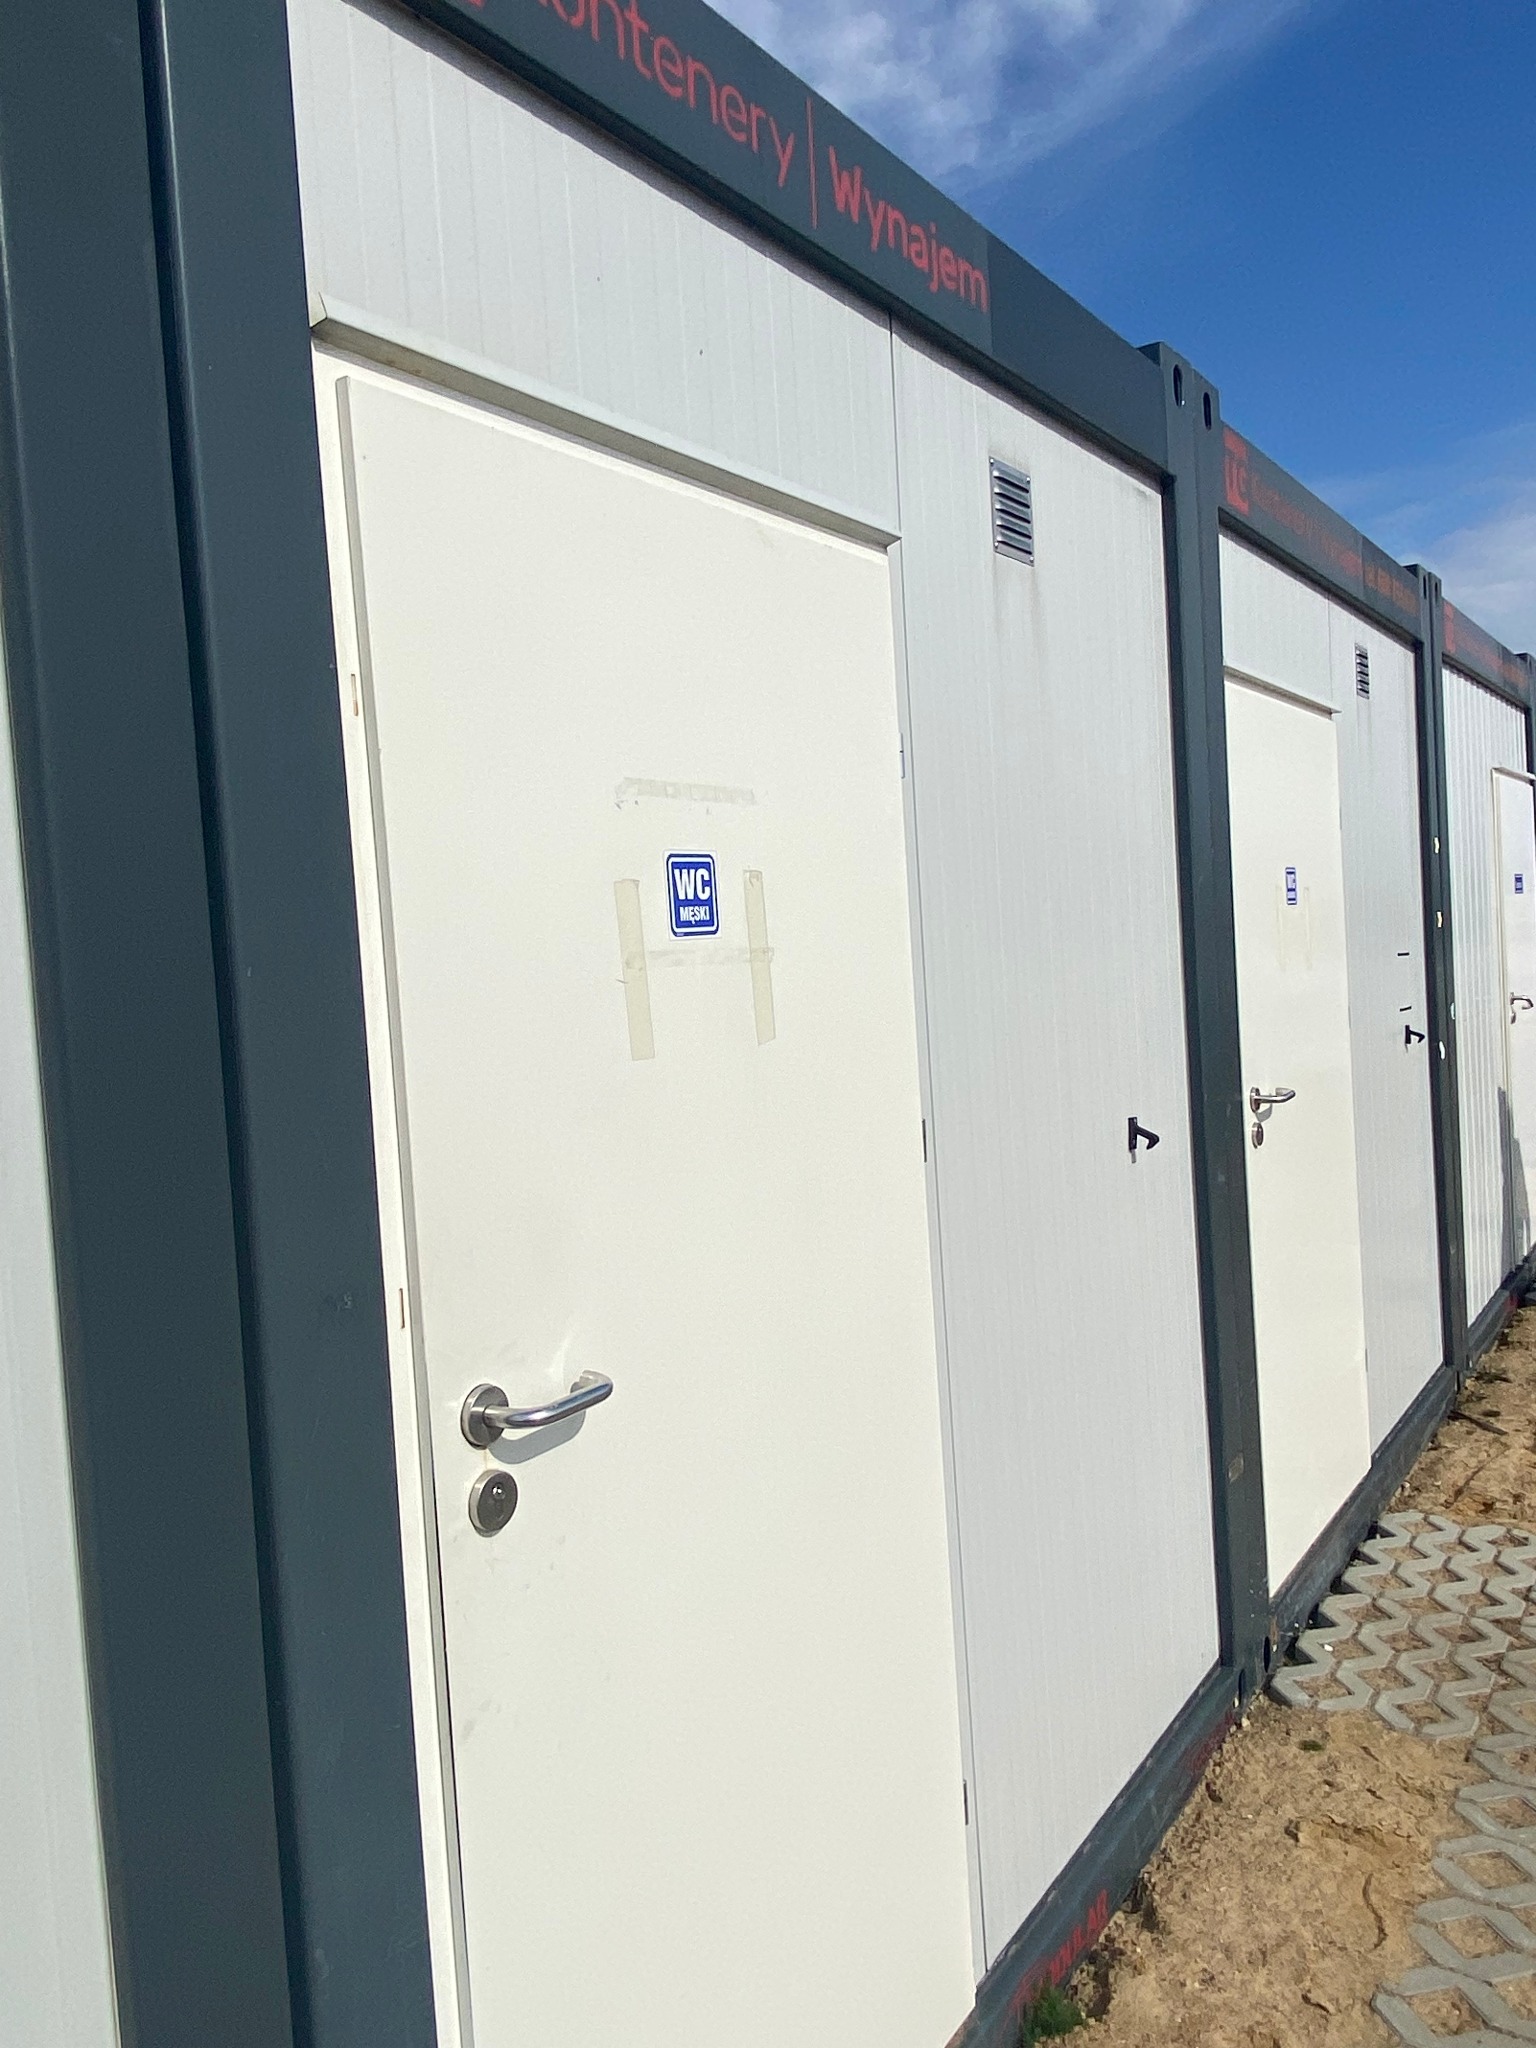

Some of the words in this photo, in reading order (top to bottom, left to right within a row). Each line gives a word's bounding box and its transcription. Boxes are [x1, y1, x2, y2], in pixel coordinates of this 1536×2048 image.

[539, 0, 795, 187] ntenery
[829, 147, 989, 312] Wynajem
[673, 868, 711, 900] WC
[679, 905, 710, 924] MĘSKI
